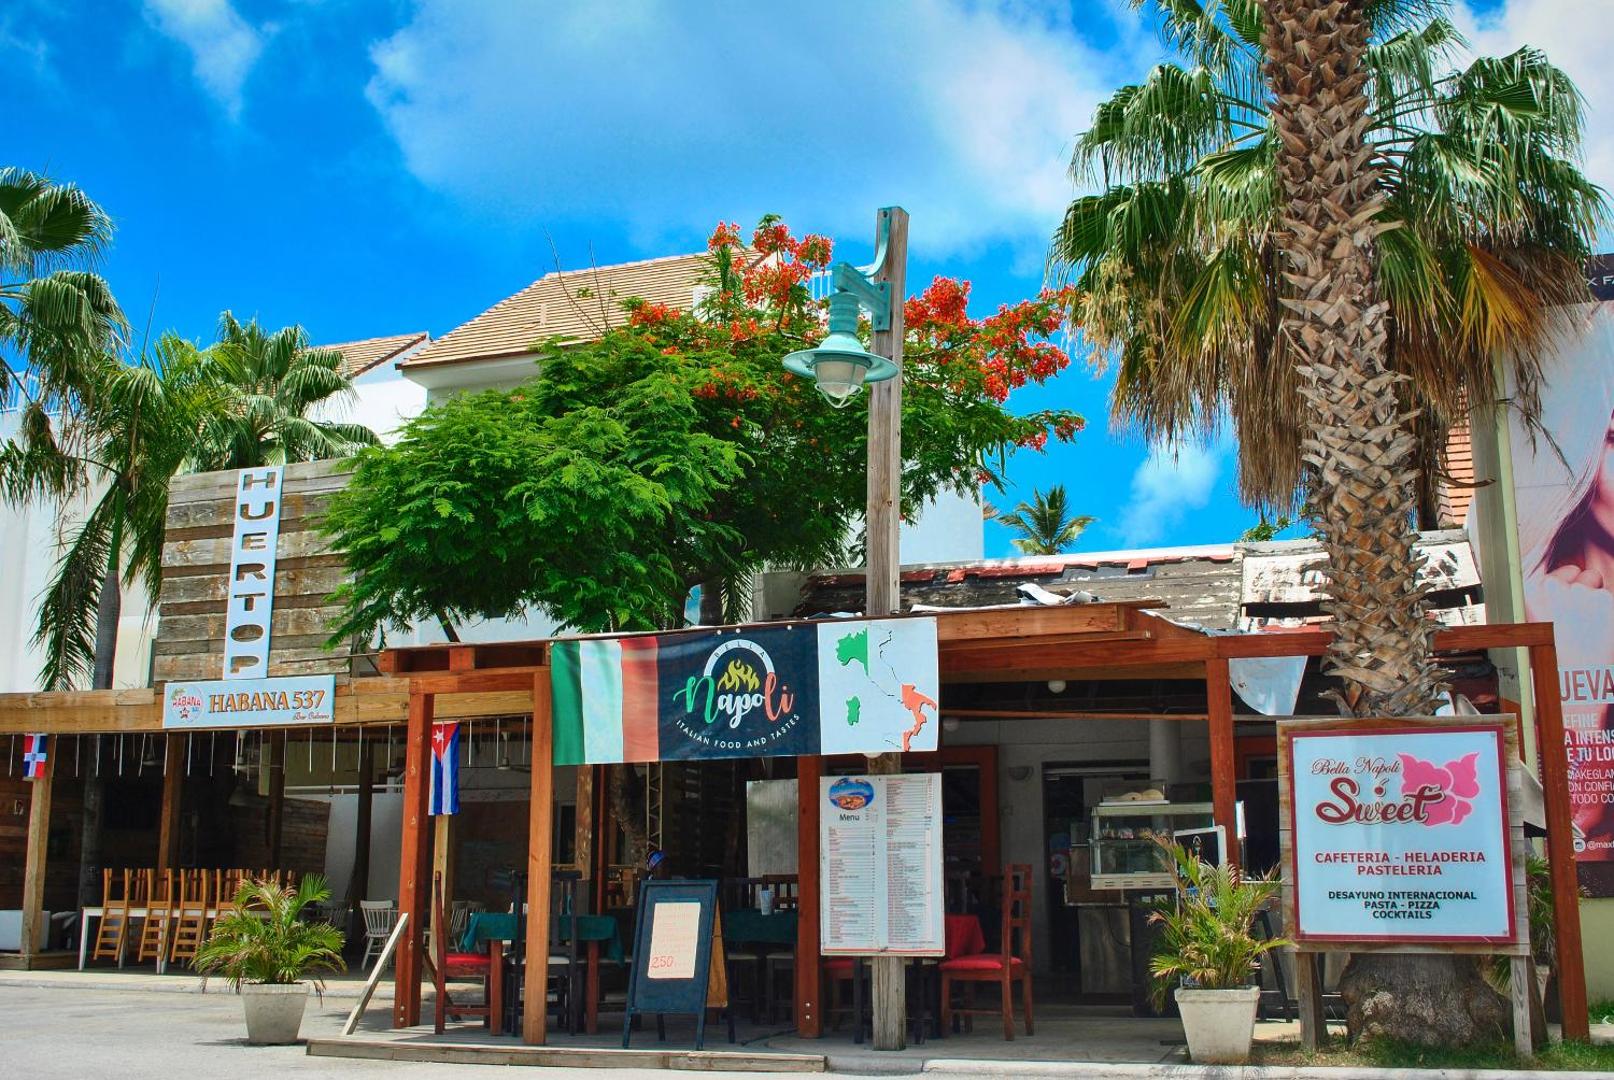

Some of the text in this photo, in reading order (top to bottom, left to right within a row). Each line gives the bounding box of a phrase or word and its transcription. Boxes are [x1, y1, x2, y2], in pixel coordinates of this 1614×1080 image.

[1603, 276, 1614, 285] F
[230, 471, 277, 674] HUERTOP
[714, 641, 765, 658] BELLA
[208, 690, 325, 713] HABANA 537
[676, 720, 710, 745] ITALIAN
[747, 737, 767, 748] AND
[770, 713, 800, 741] TASTES
[1596, 746, 1614, 761] LO
[1311, 756, 1400, 779] Bella Napoli
[1314, 777, 1446, 825] Sweet
[1315, 853, 1390, 863] CAFETERIA
[1404, 852, 1486, 863] HELADERIA
[1357, 865, 1442, 876] PASTELERIA
[1328, 891, 1477, 900] DESAYUNO INTERNACIONAL
[1364, 901, 1396, 909] PASTA
[1408, 901, 1440, 909] PIZZA
[1372, 910, 1432, 919] COCKTAILS
[650, 955, 674, 969] 250
